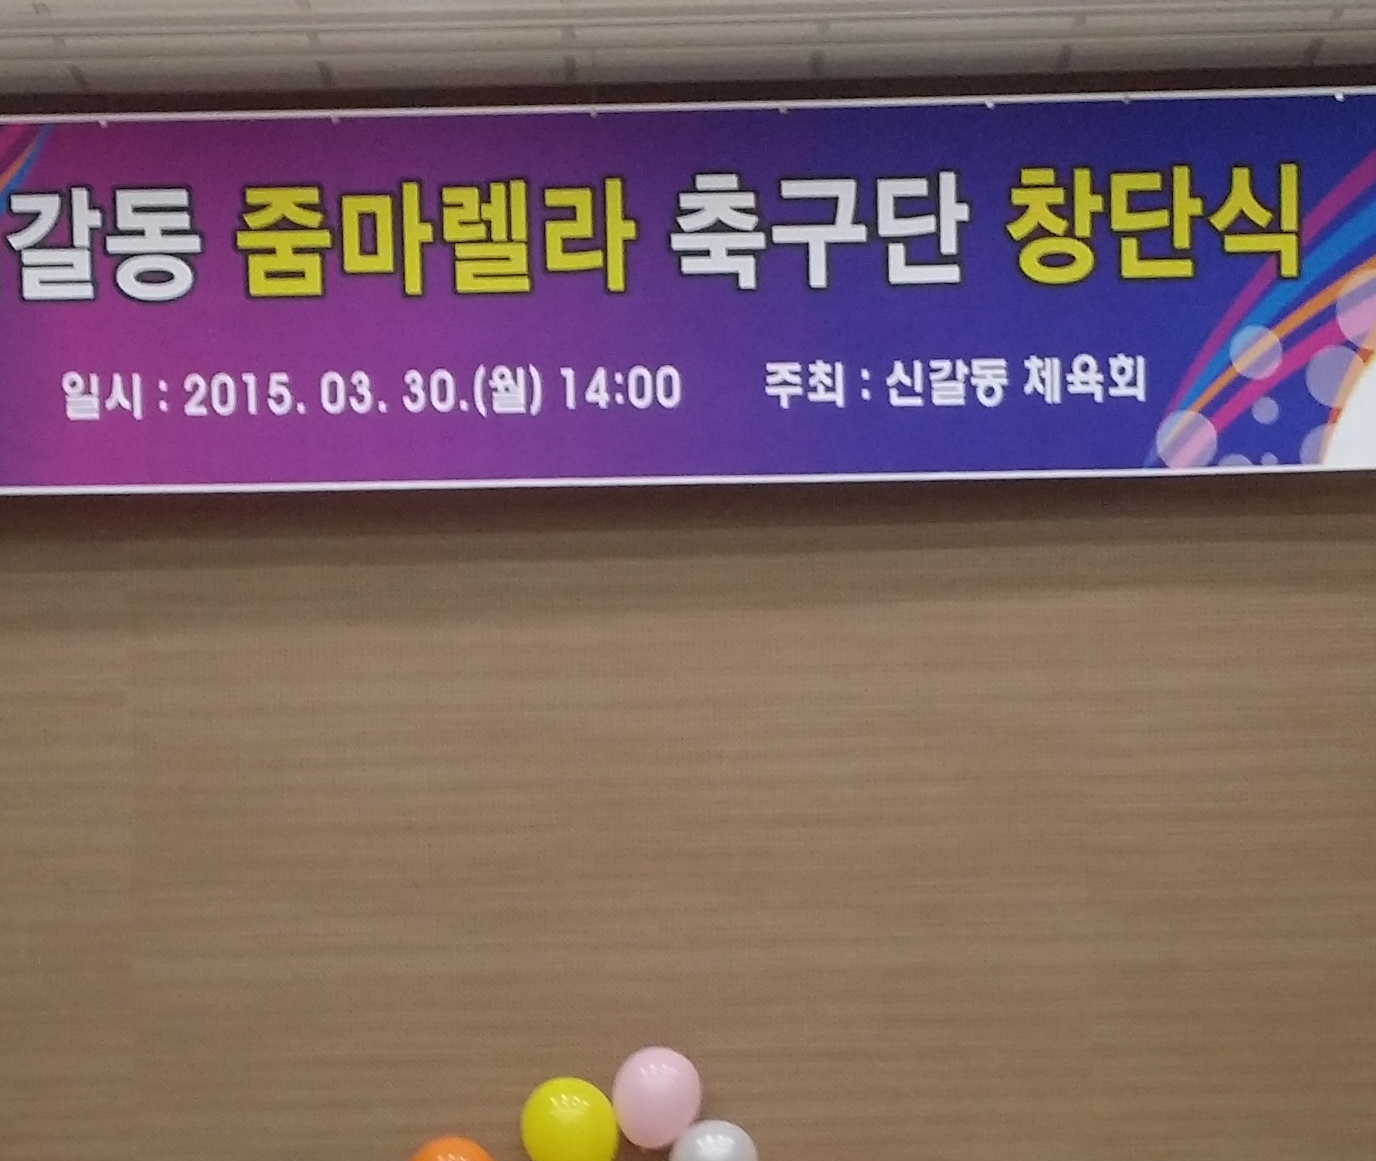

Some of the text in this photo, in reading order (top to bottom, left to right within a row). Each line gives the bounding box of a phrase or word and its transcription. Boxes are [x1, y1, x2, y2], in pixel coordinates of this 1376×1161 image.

[234, 177, 636, 298] 줌마렐라
[669, 170, 971, 290] 축구단
[1005, 163, 1301, 285] 창단식
[60, 370, 143, 421] 일시
[182, 370, 307, 417] 2015.
[320, 369, 388, 415] 03.
[559, 363, 684, 411] 14:00
[764, 358, 846, 409] 주최
[885, 356, 1010, 408] 신갈동
[1023, 353, 1148, 405] 체육회
